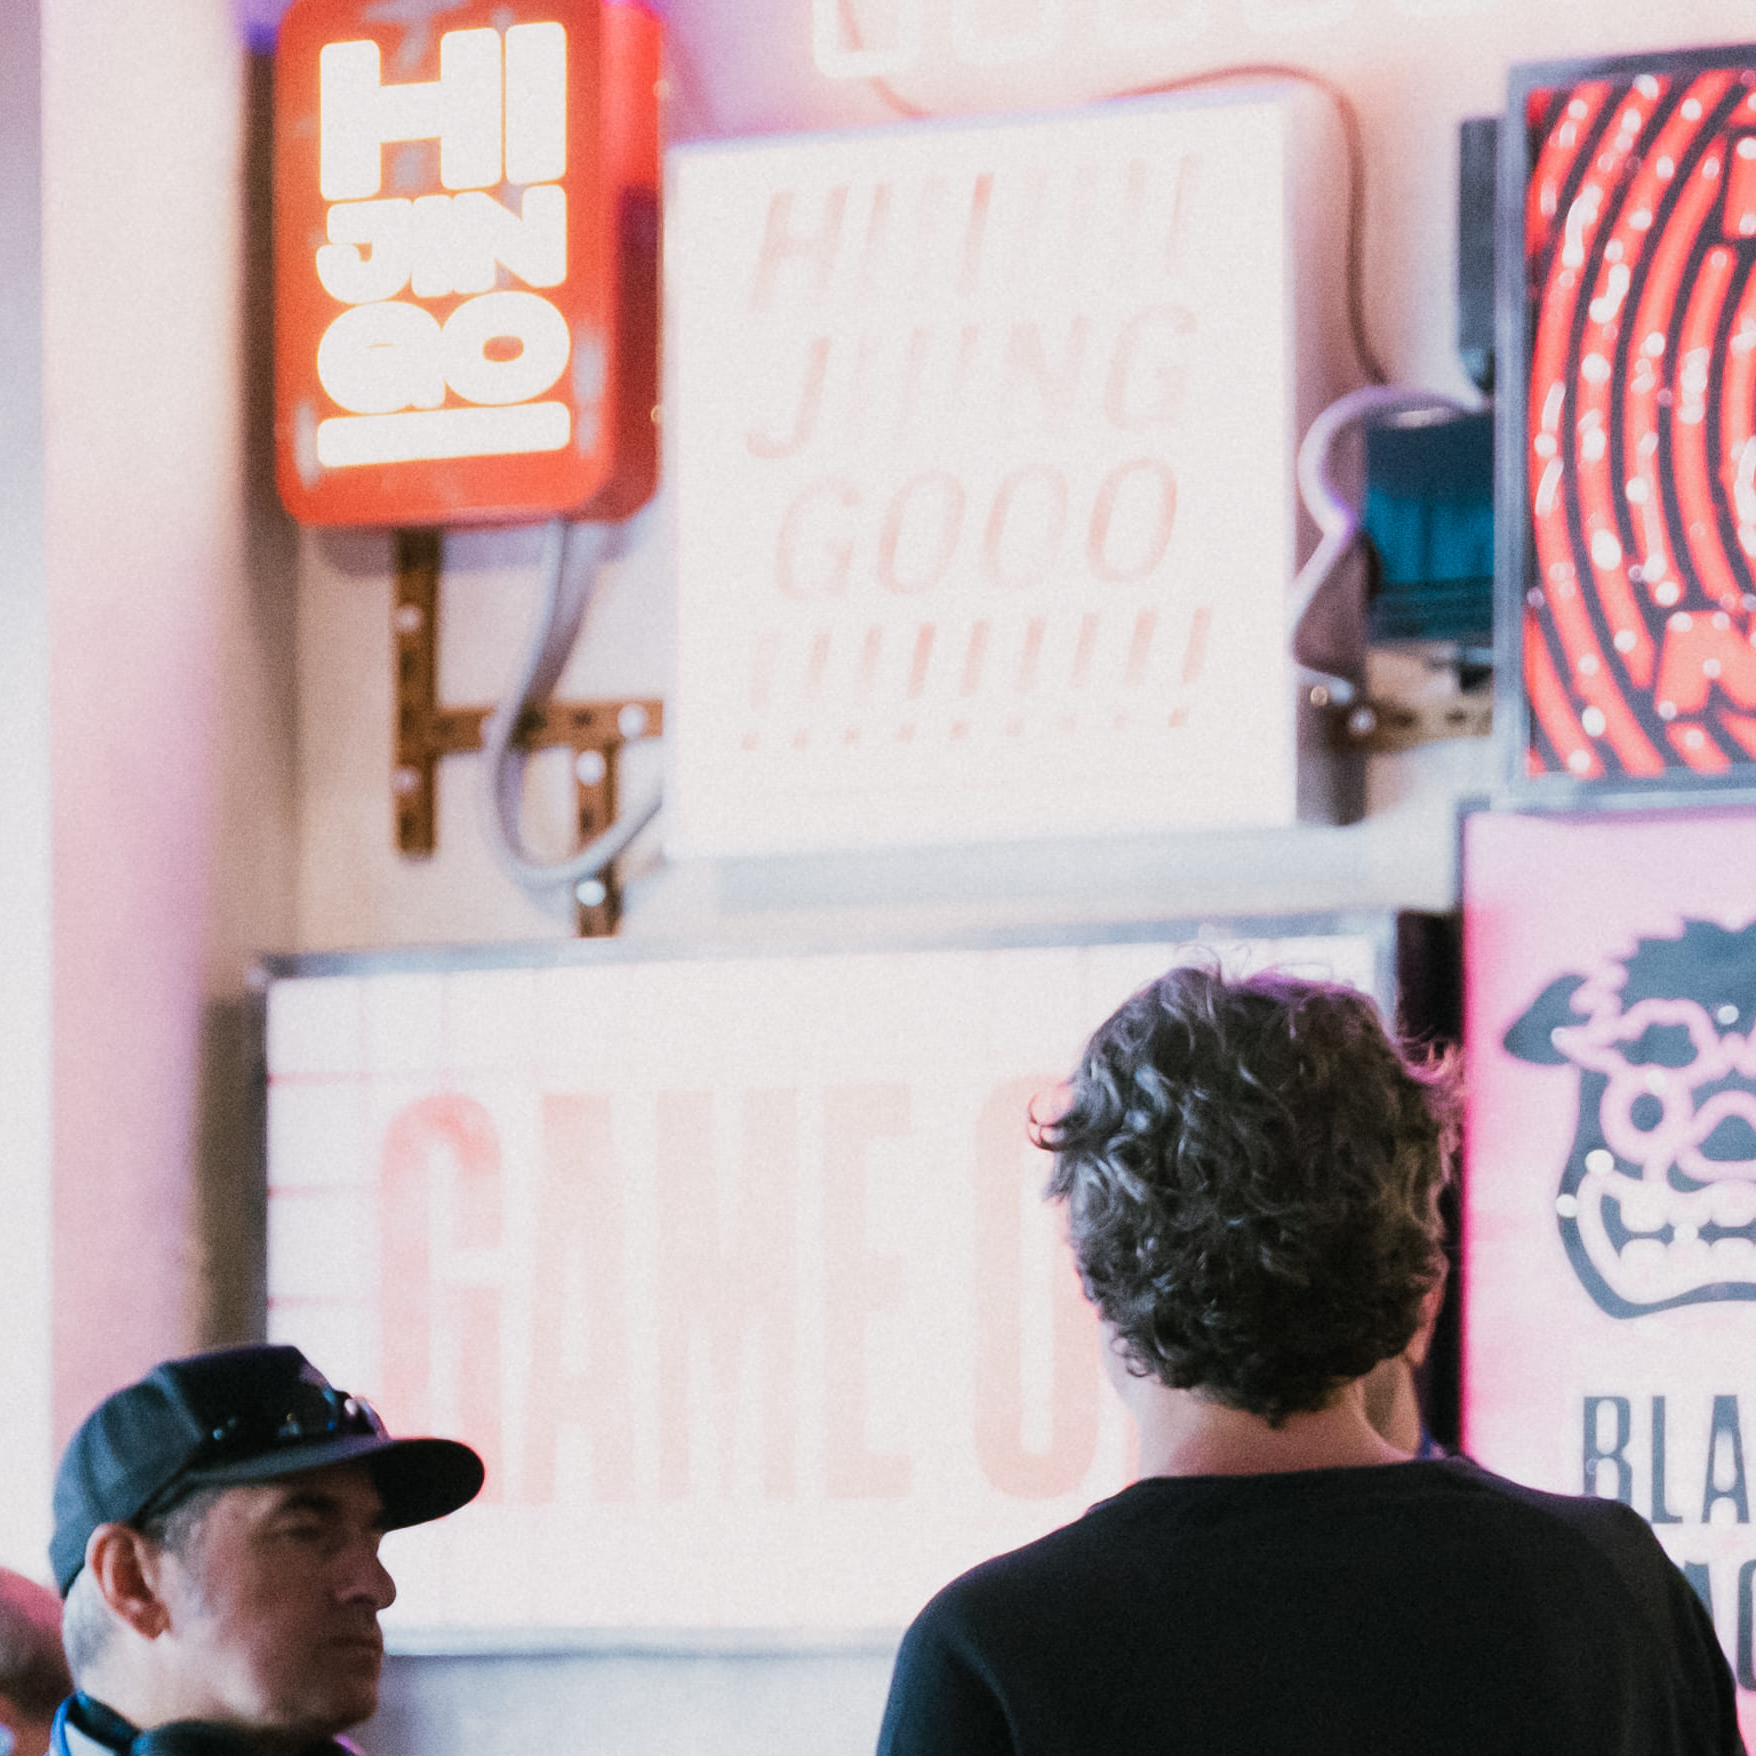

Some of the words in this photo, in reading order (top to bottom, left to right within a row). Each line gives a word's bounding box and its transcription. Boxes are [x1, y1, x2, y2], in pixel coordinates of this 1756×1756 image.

[319, 20, 567, 202] HI
[315, 184, 567, 304] JIN
[316, 290, 571, 415] GO
[772, 455, 1179, 602] GOOO
[378, 1080, 914, 1508] GAME
